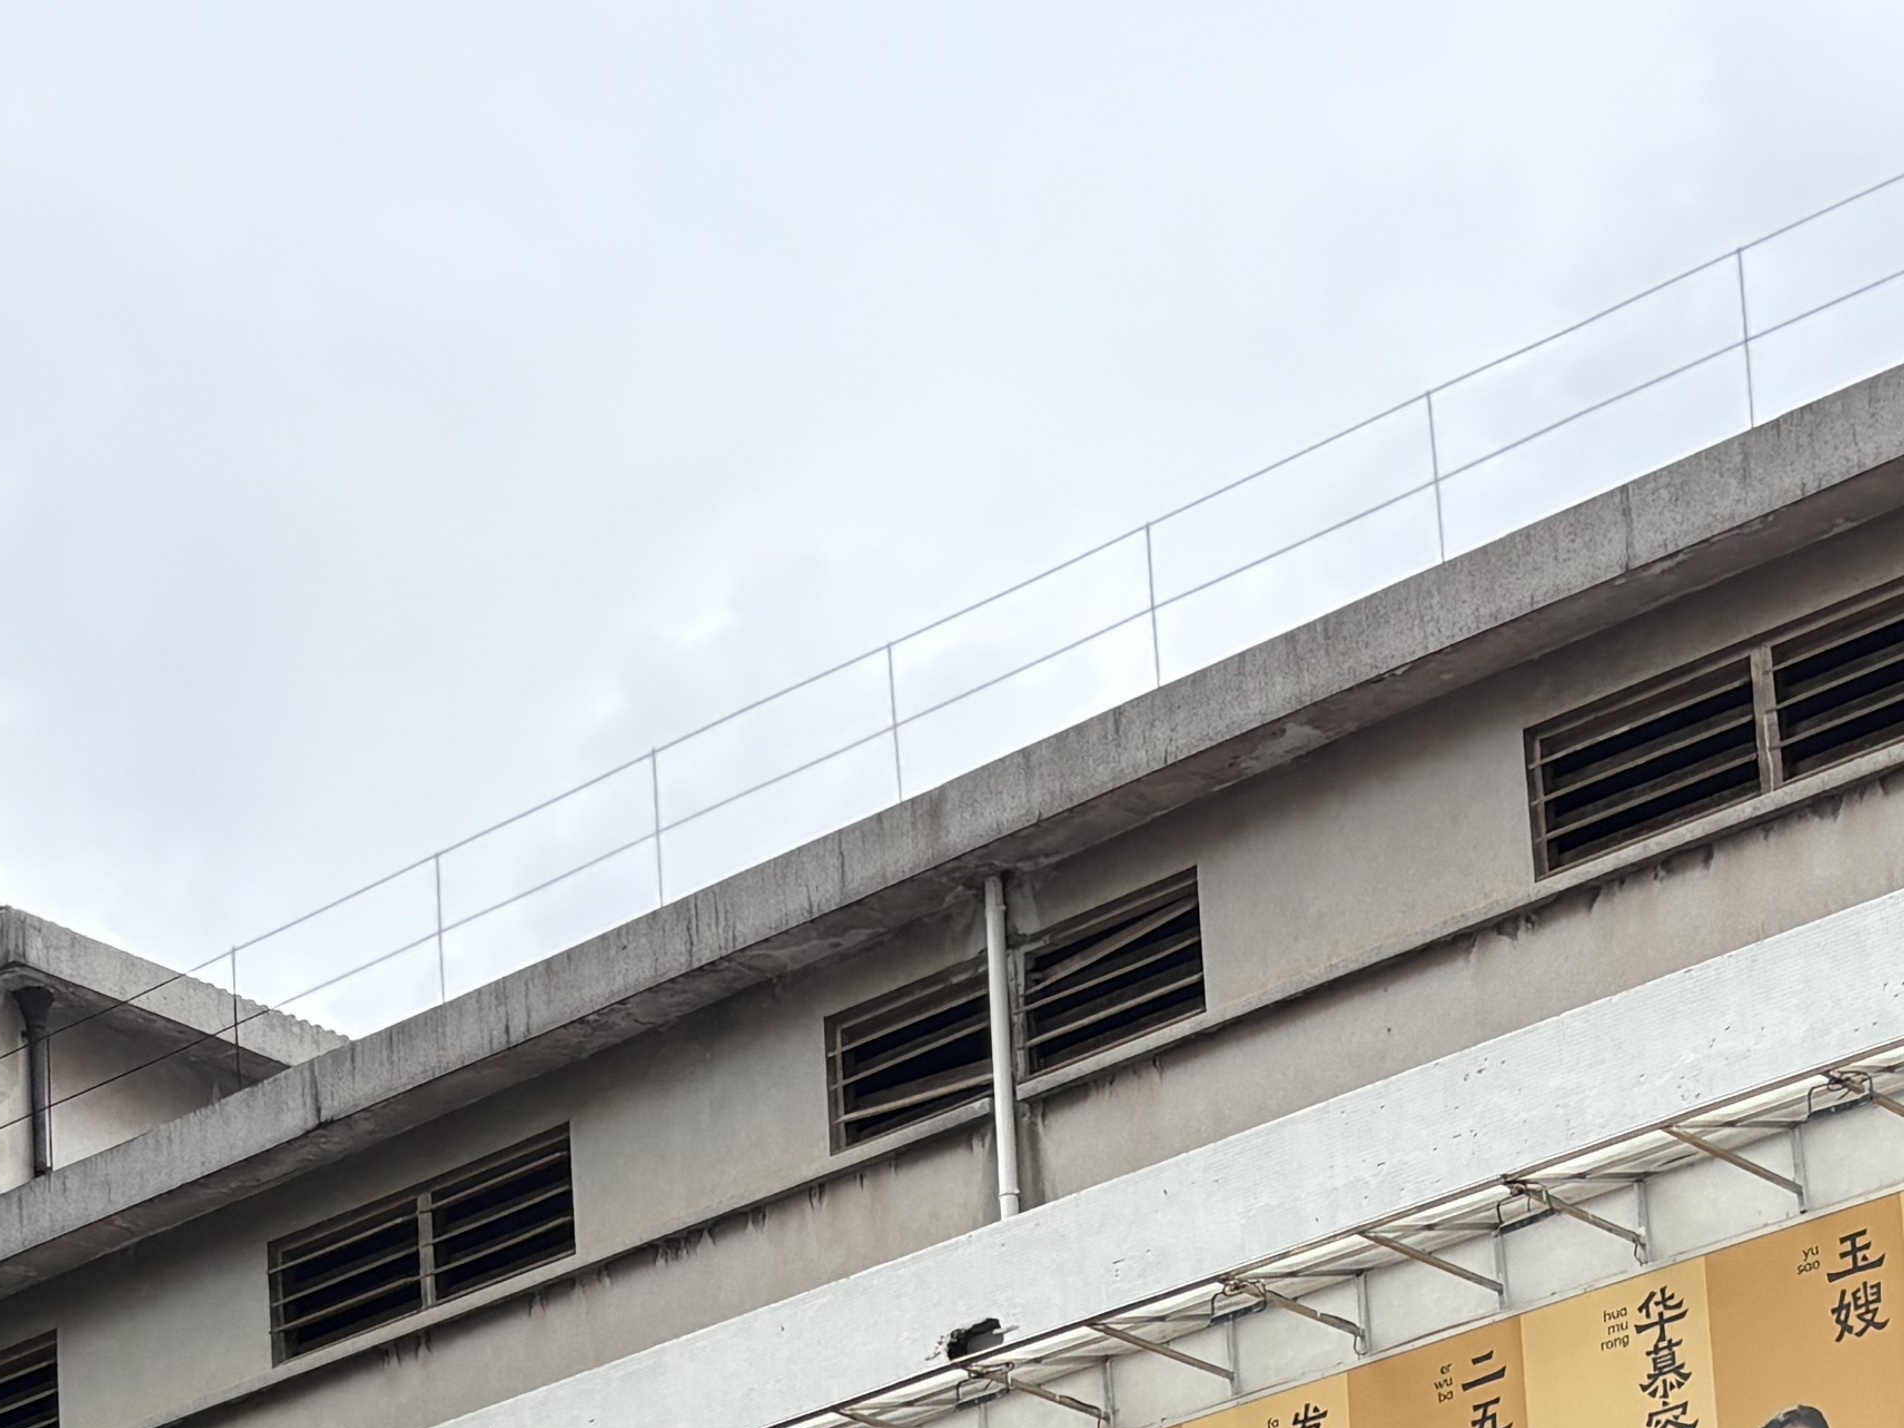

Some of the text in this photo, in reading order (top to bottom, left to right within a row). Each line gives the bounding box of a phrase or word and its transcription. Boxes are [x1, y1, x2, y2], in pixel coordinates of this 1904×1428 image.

[1802, 1245, 1820, 1264] yu
[1827, 1229, 1890, 1342] 玉嫂
[1603, 1306, 1628, 1323] hua
[1608, 1320, 1629, 1335] mu
[1601, 1334, 1630, 1352] rong
